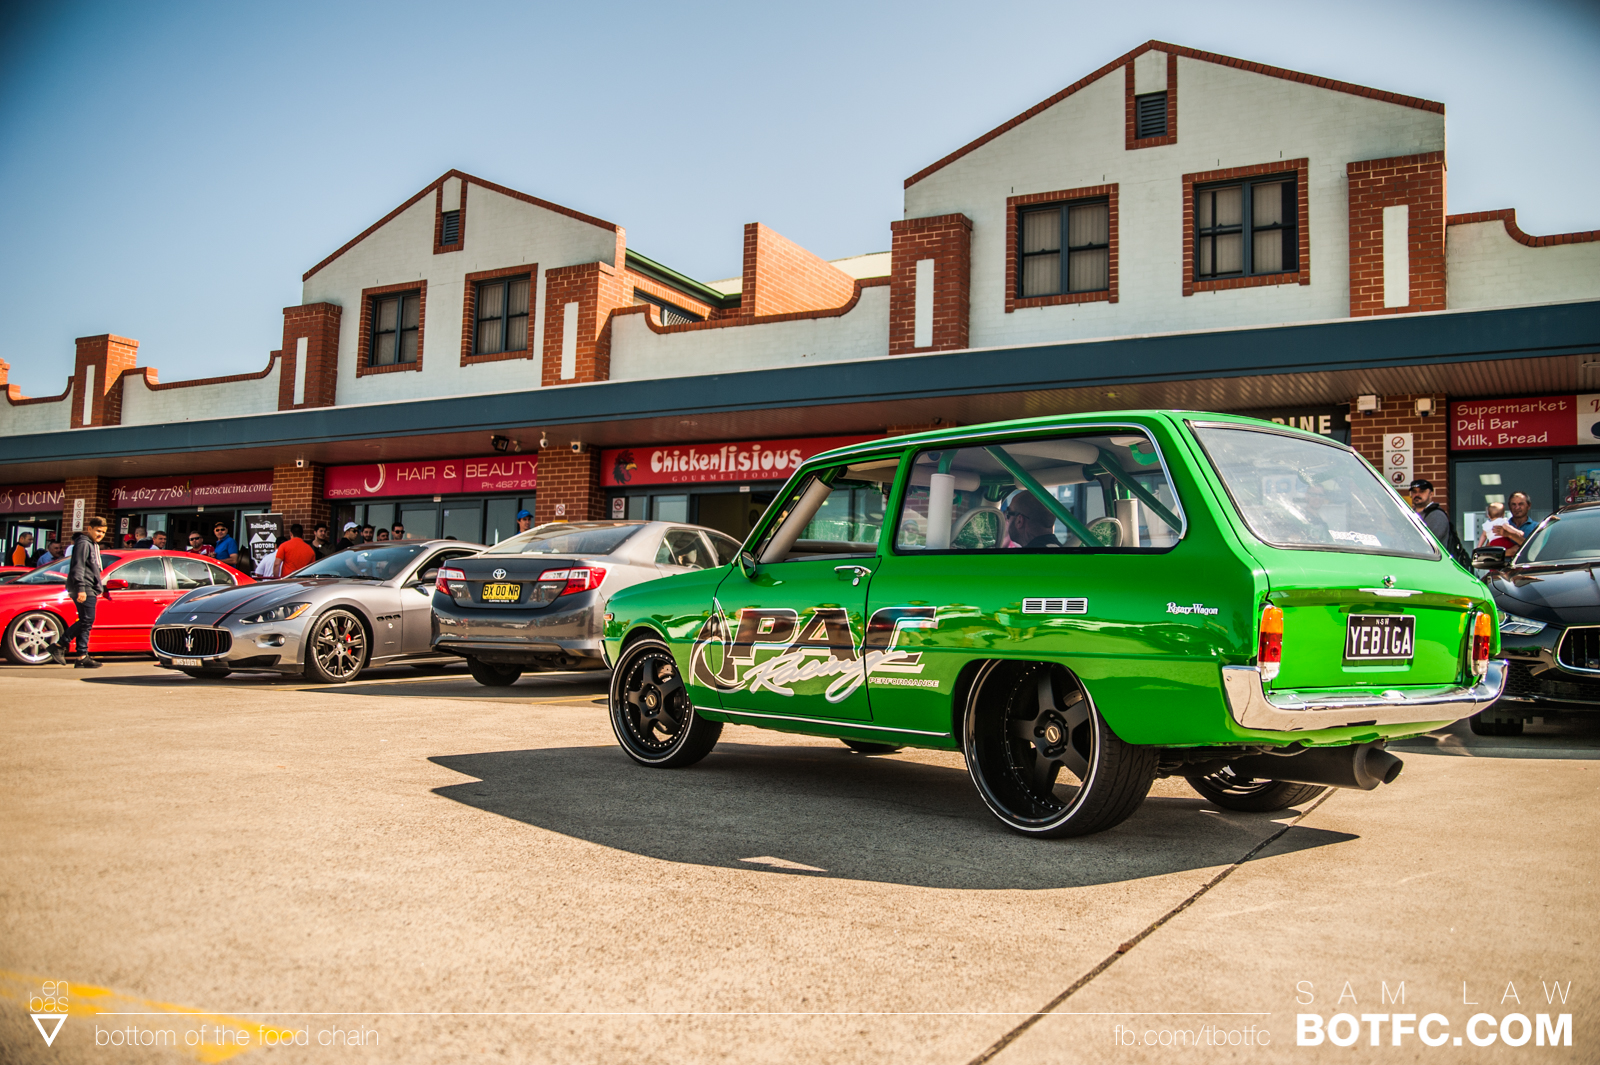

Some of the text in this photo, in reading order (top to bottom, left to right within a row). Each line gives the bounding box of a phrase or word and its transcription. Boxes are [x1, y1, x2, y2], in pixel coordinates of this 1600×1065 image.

[1457, 400, 1568, 420] Supermarket
[1457, 418, 1519, 431] Deli Bar
[1457, 431, 1548, 447] Milk, Bread
[650, 444, 804, 474] Chickenlisious
[397, 461, 539, 481] HAIR & BEAUTY
[672, 471, 779, 482] GOURMET FOOD
[328, 488, 361, 496] CRIMSON
[495, 480, 519, 488] 4627
[0, 488, 66, 509] OS CUCINA
[131, 487, 157, 502] 4627
[158, 485, 184, 501] 7788
[1192, 603, 1218, 616] Wagon
[727, 606, 939, 674] PAC
[1350, 625, 1412, 655] YEBIGA
[743, 650, 909, 703] Racing
[868, 677, 940, 688] PERFORMANCE
